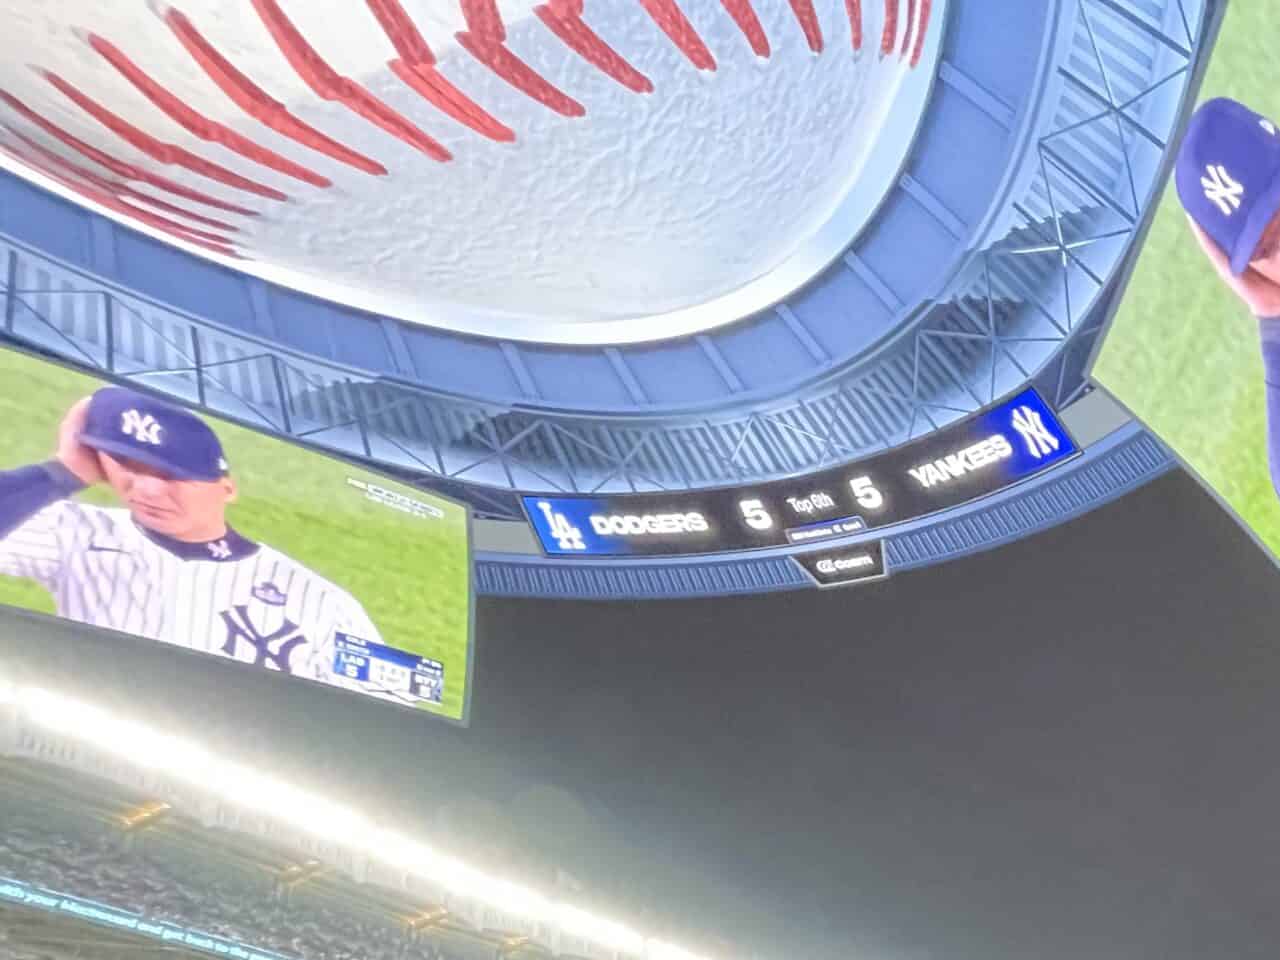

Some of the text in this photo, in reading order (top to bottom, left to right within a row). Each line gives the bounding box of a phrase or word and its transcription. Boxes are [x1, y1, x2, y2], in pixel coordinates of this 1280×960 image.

[849, 476, 883, 509] 5
[908, 434, 1013, 488] YANKEES
[589, 512, 710, 535] DODGERS
[739, 498, 774, 531] 5
[786, 497, 813, 513] Top
